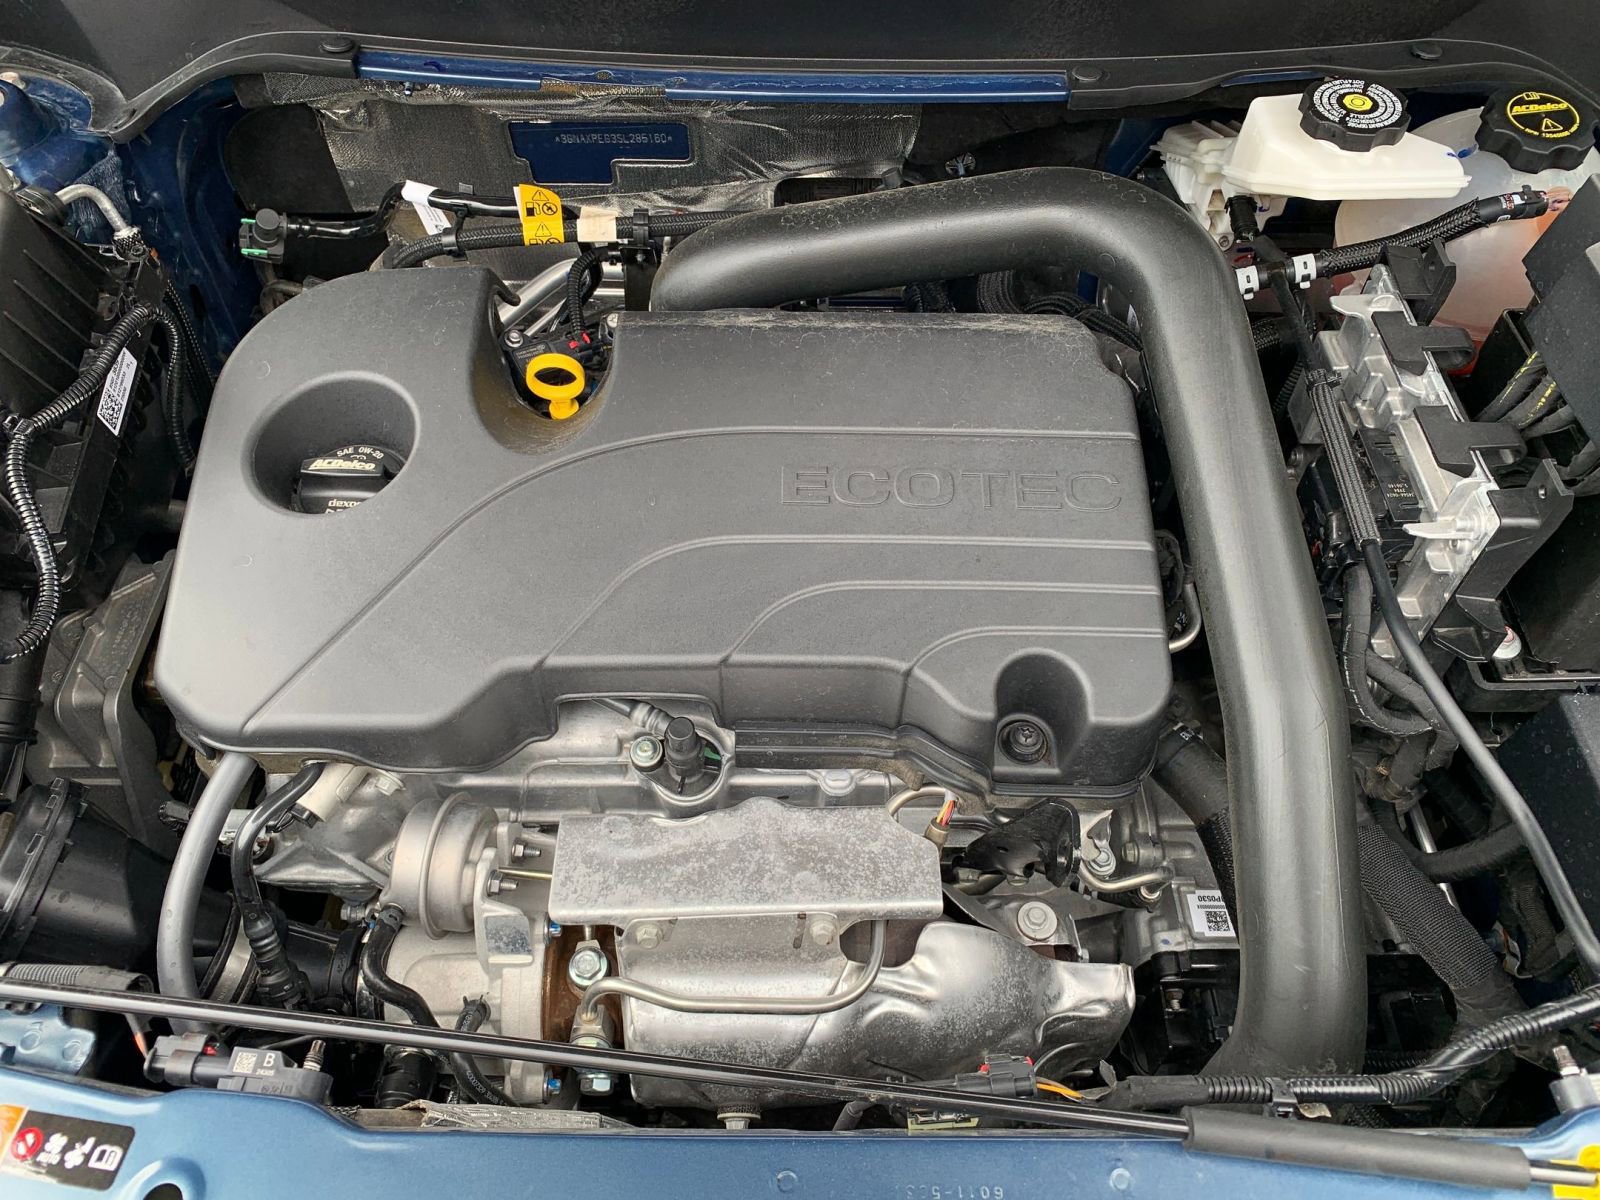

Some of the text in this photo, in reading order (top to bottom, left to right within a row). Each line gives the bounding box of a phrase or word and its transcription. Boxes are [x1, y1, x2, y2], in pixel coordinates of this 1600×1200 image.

[1511, 102, 1568, 114] ACDelco
[336, 446, 384, 459] SAE 0W-20
[308, 459, 376, 471] ACDelco
[781, 465, 1122, 512] ECOTEC
[263, 1052, 276, 1067] B
